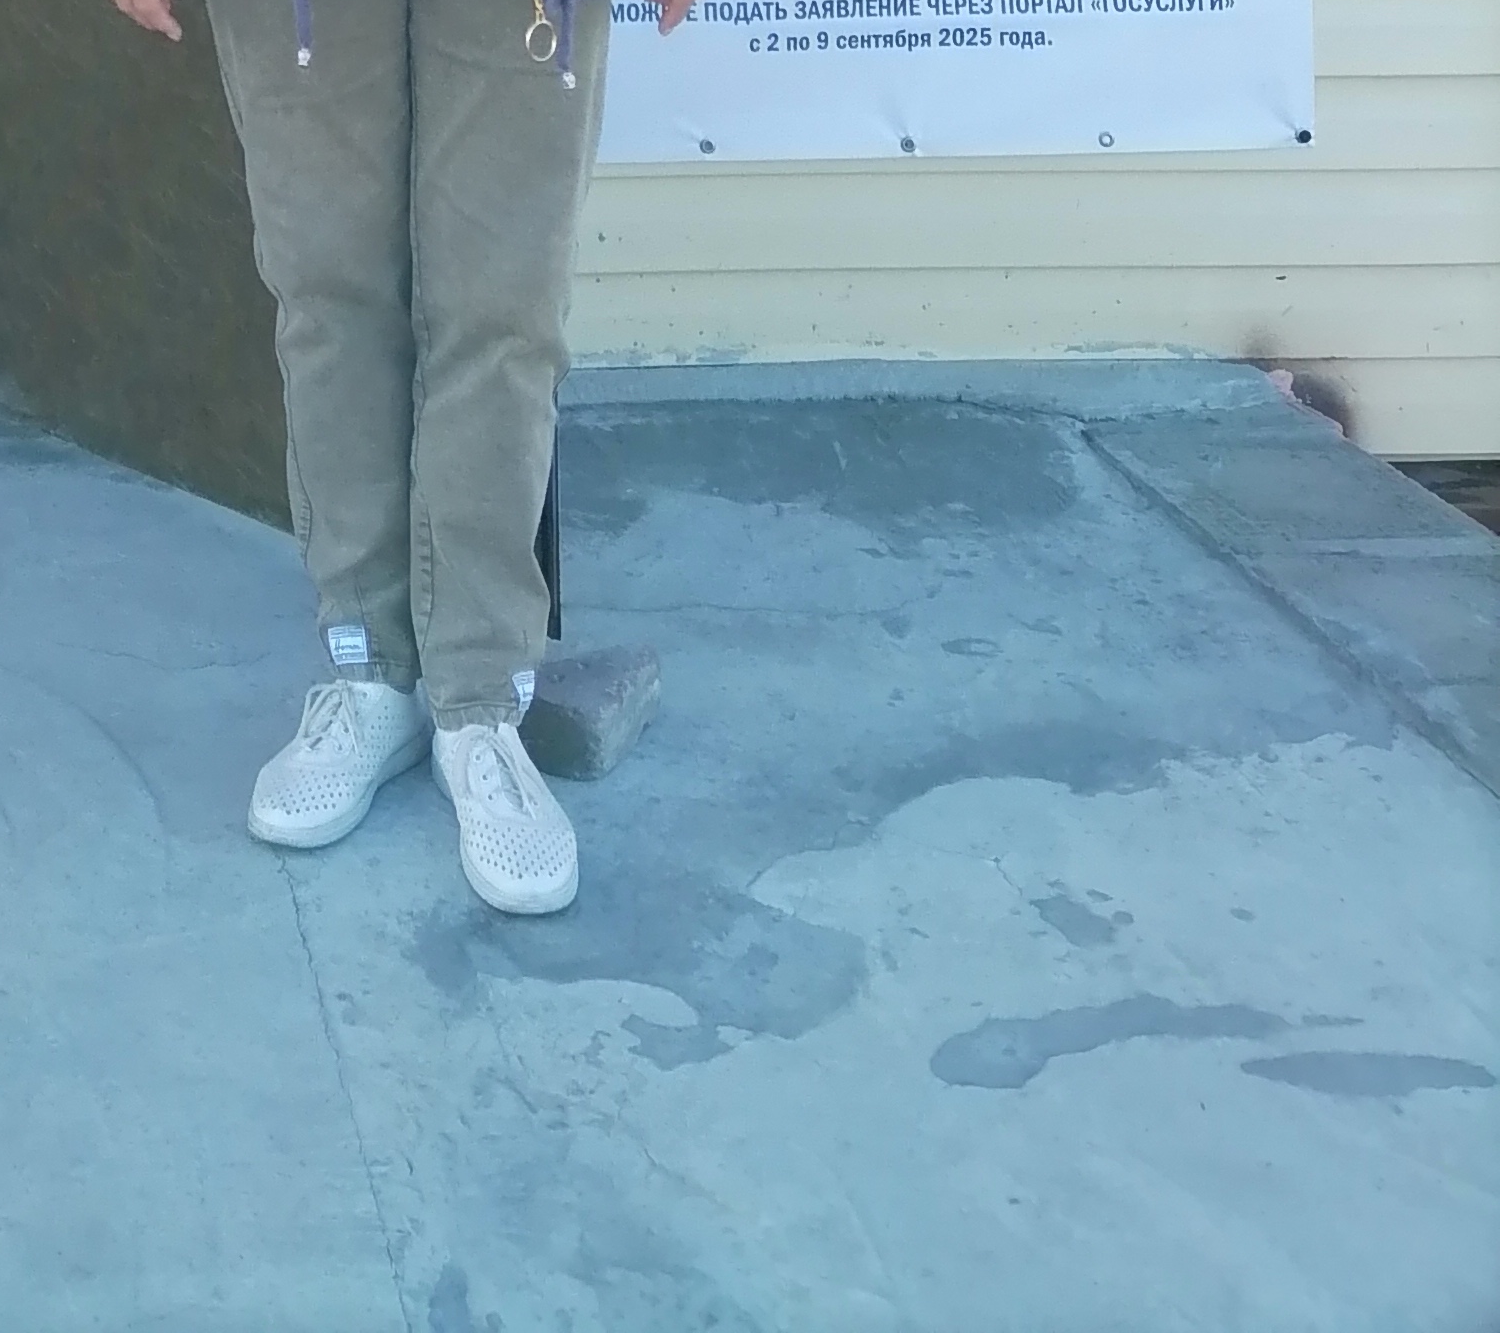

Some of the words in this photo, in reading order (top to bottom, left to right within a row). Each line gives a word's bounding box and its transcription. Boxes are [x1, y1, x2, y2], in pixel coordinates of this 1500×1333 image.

[749, 33, 761, 52] с
[766, 29, 779, 50] 2
[786, 34, 811, 55] по
[817, 28, 830, 49] 9
[836, 27, 932, 54] сентября
[938, 26, 991, 48] 2025
[998, 28, 1053, 48] года.
